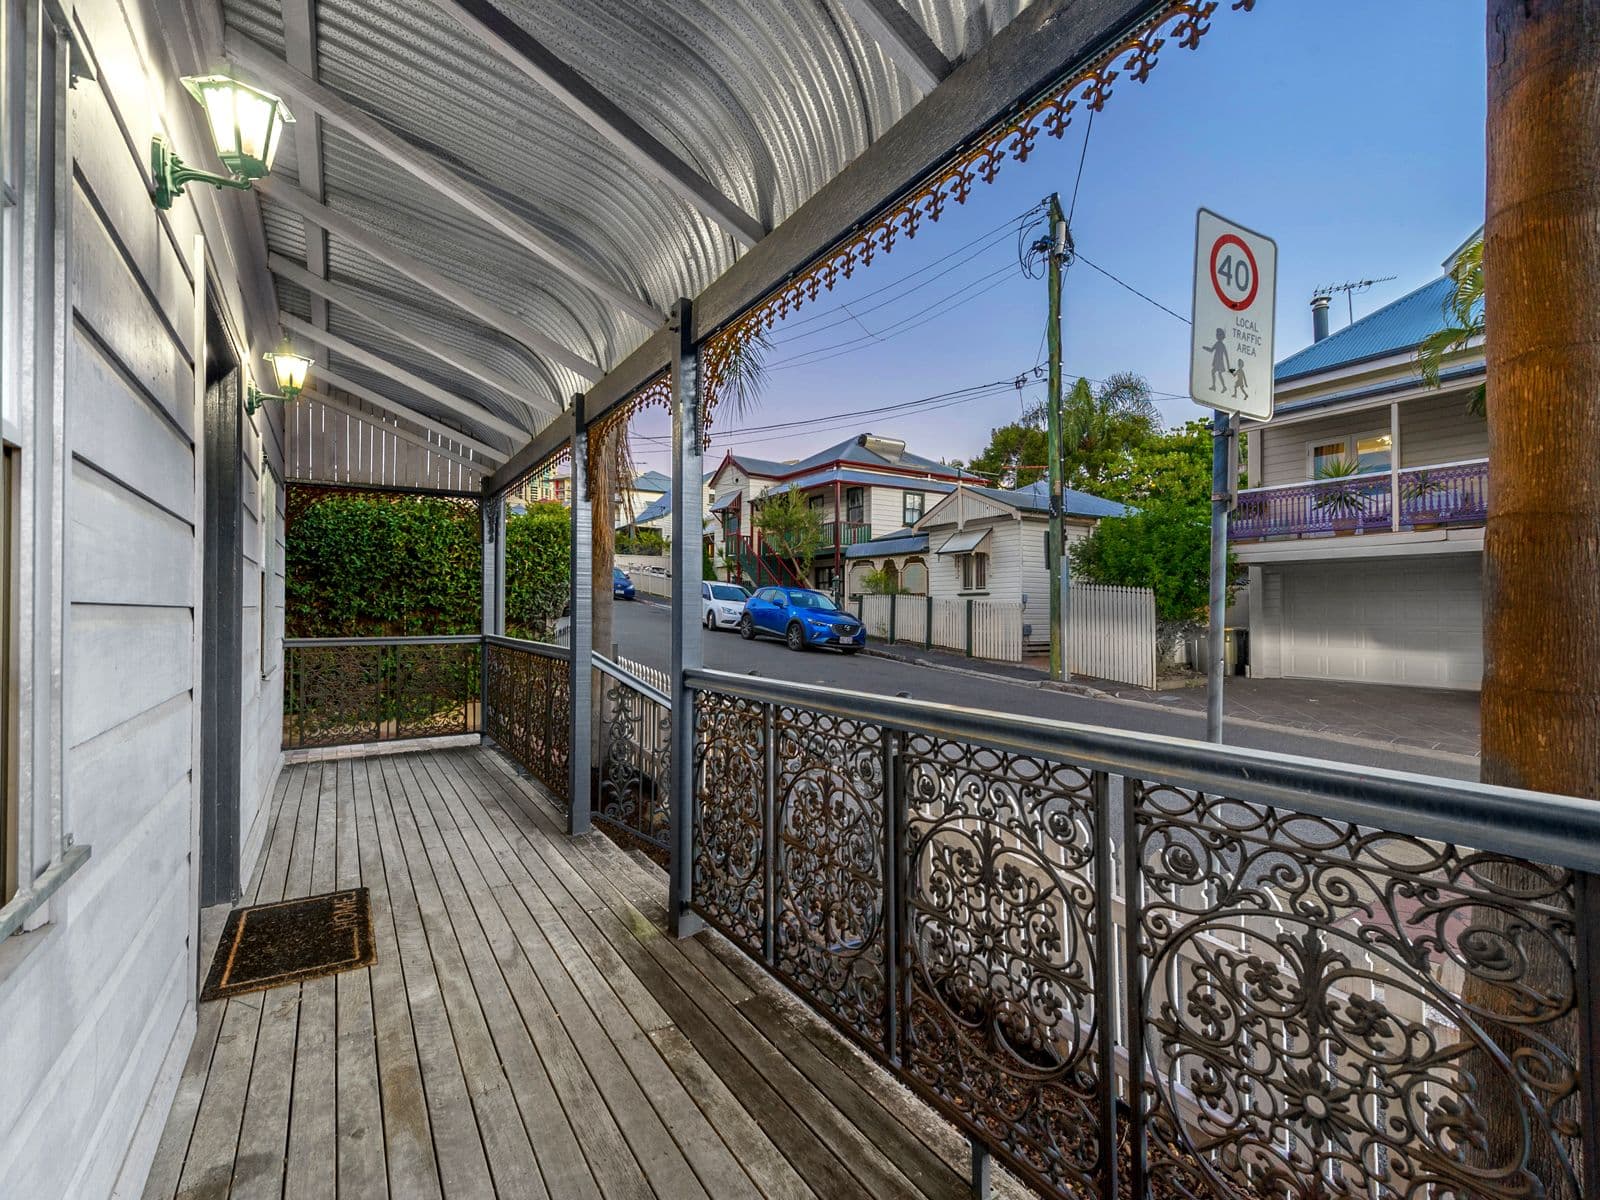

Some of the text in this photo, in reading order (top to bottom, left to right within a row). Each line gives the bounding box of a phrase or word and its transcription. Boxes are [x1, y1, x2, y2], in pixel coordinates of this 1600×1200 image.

[1217, 254, 1249, 292] 40
[1235, 316, 1259, 333] LOCAL
[1232, 327, 1262, 346] TRAFFIC
[1236, 342, 1257, 357] AREA
